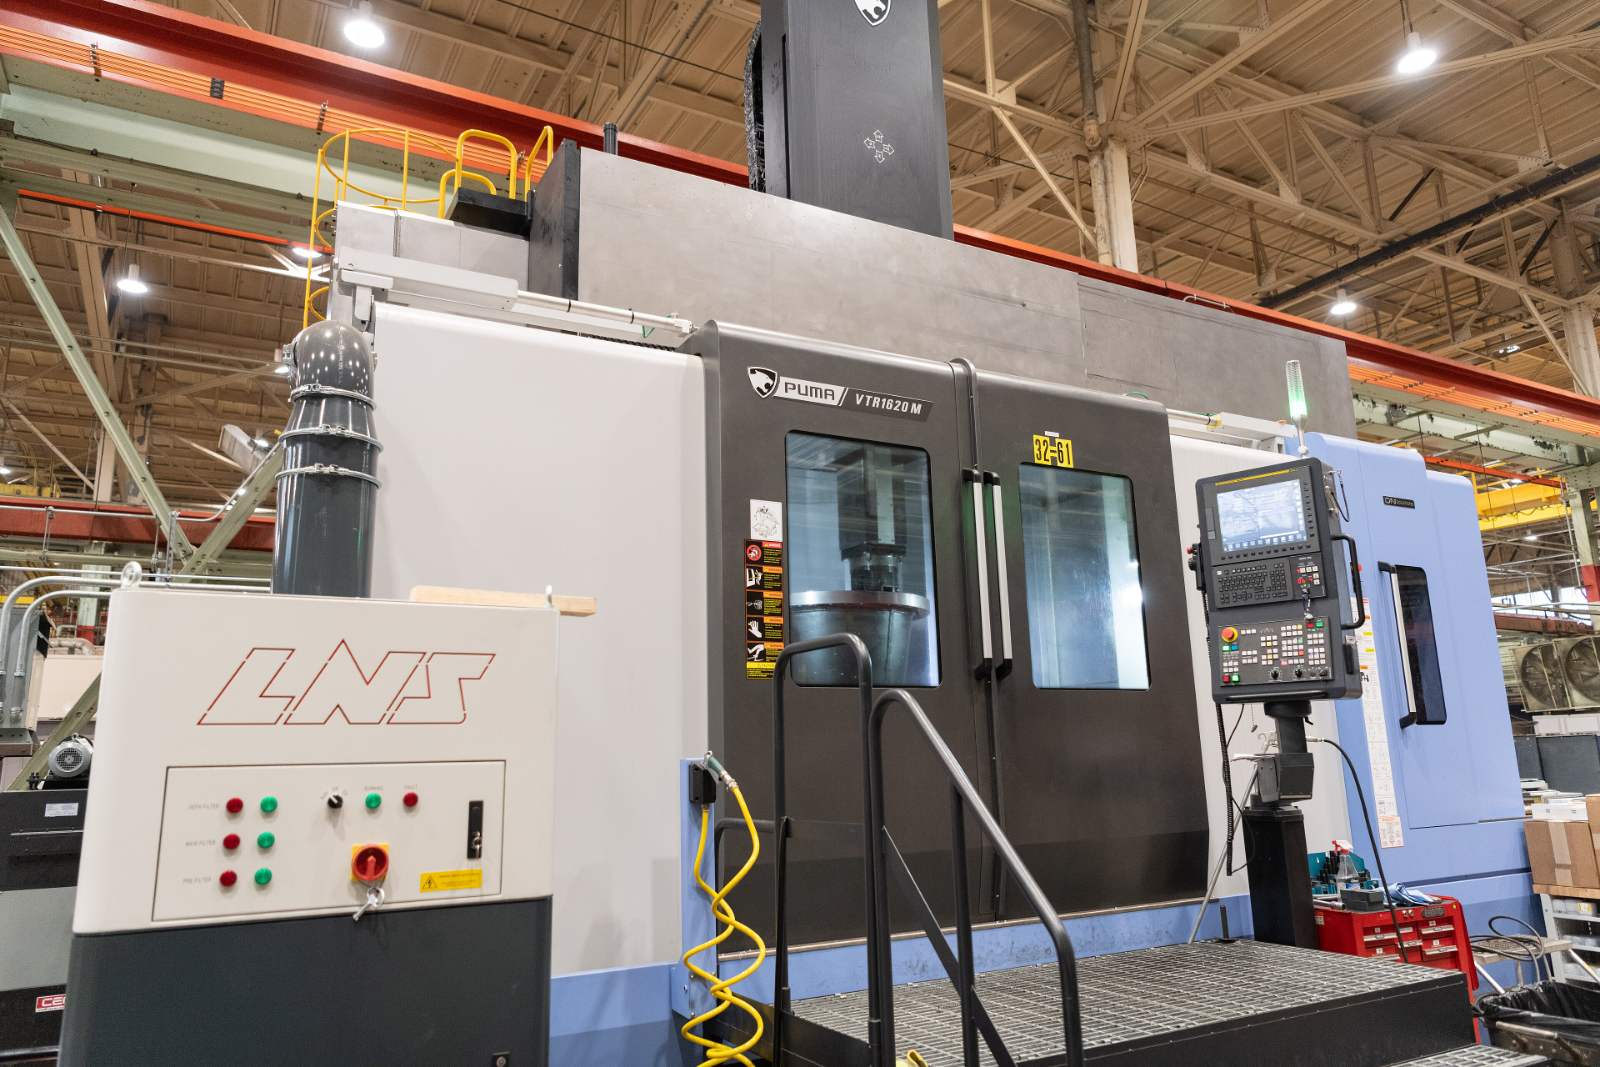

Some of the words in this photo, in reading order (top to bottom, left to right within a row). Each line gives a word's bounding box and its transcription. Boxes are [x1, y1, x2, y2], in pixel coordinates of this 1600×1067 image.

[784, 381, 836, 401] PUMA
[855, 393, 908, 413] VTR1620
[910, 403, 922, 415] M
[1035, 438, 1071, 465] 32-61
[196, 638, 496, 726] LNS
